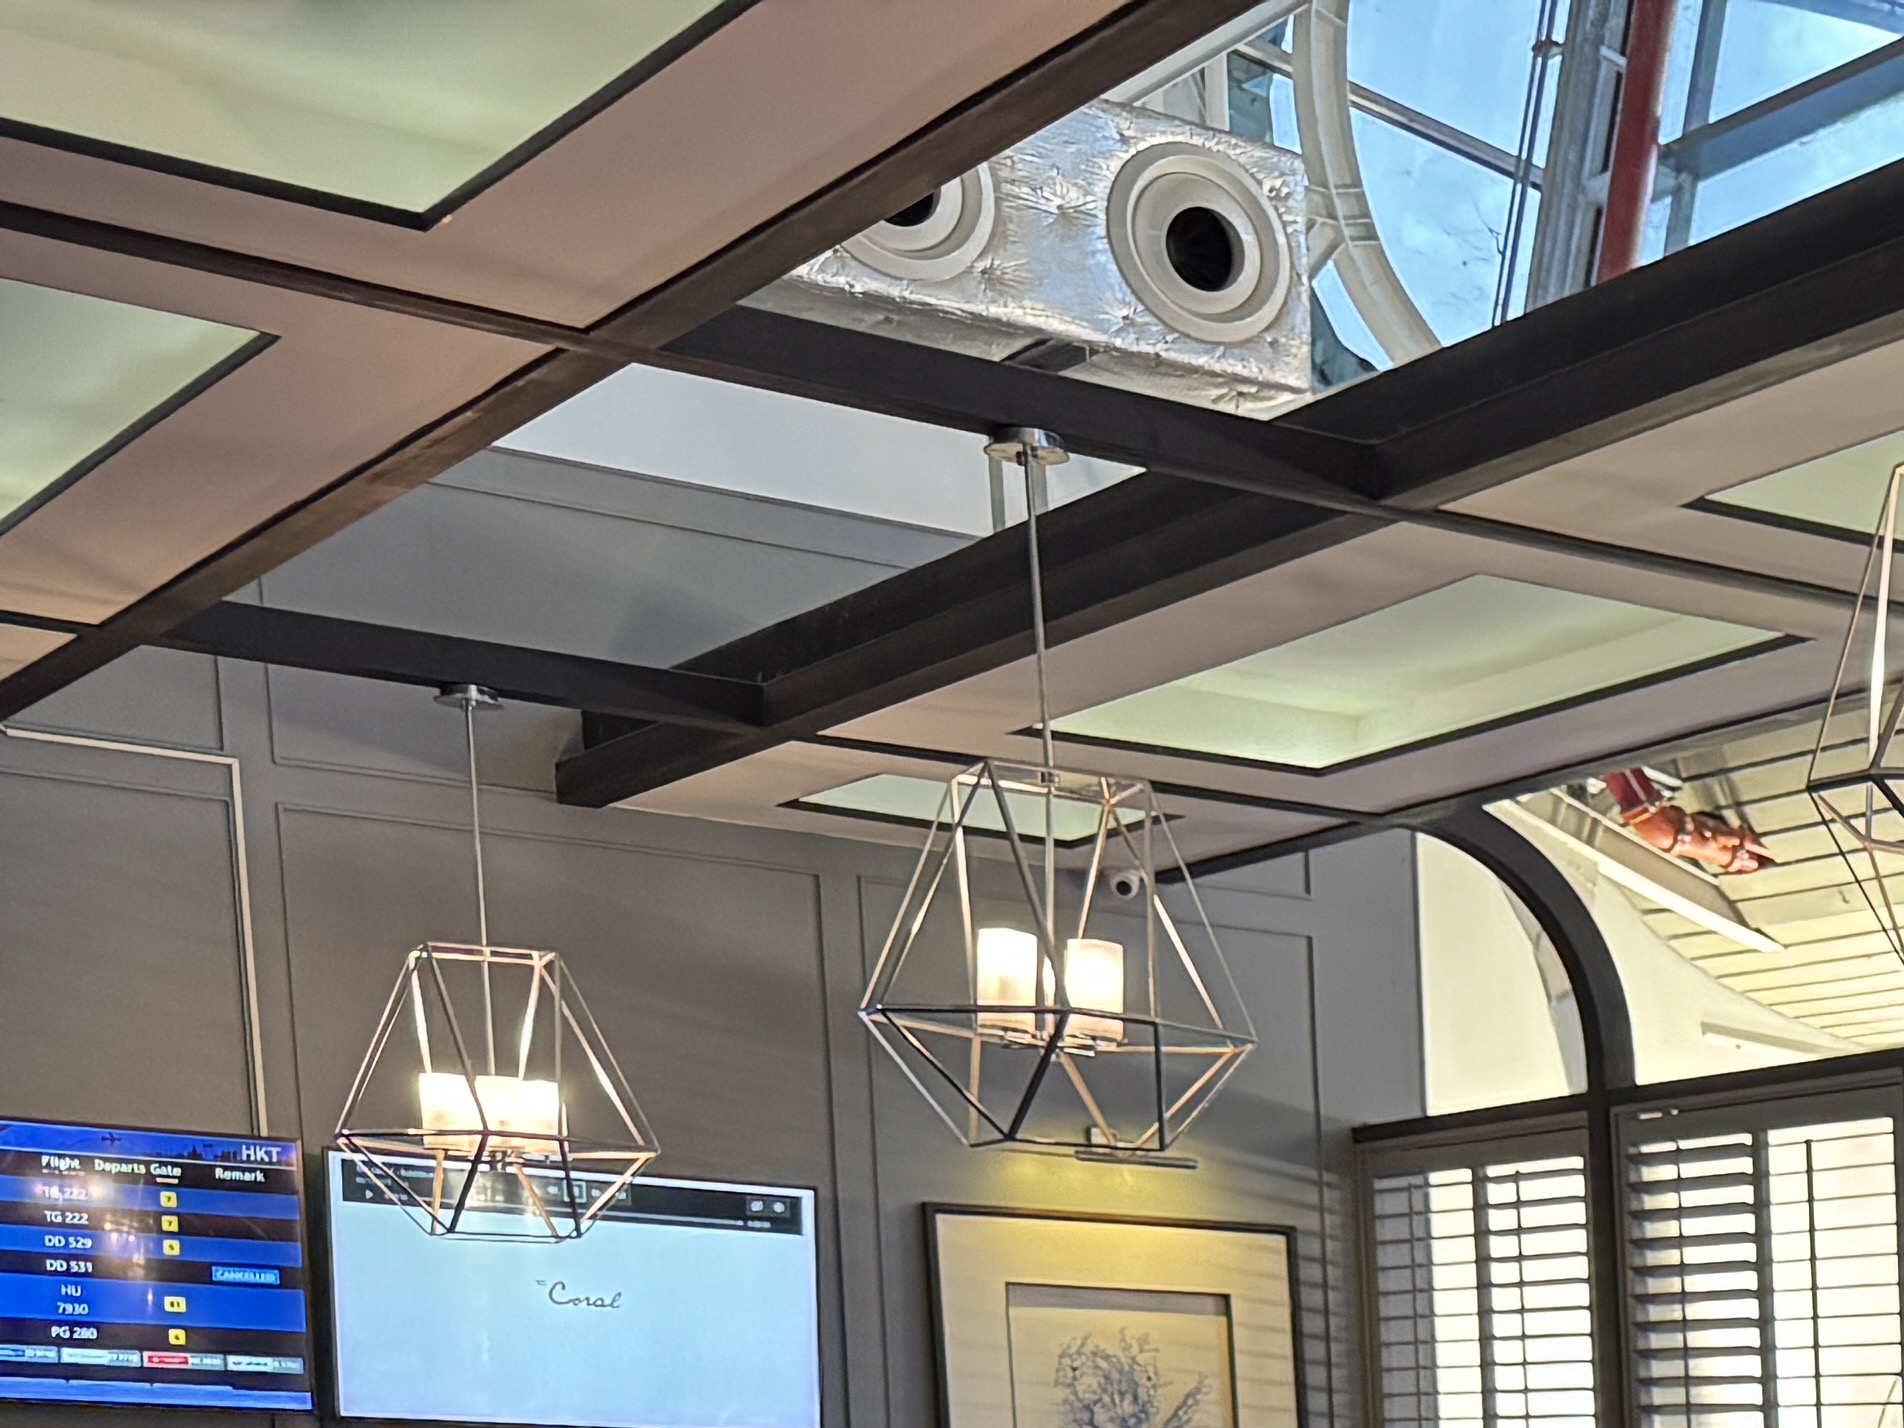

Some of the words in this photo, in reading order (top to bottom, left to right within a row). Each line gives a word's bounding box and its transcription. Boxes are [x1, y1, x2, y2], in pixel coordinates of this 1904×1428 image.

[242, 1145, 281, 1162] HKT
[41, 1155, 81, 1171] Flight
[94, 1158, 146, 1175] Departs
[150, 1163, 182, 1177] Gate
[215, 1167, 265, 1183] Remark
[63, 1187, 88, 1201] 222
[44, 1210, 62, 1223] TG
[65, 1211, 89, 1225] 222
[44, 1235, 66, 1248] DD
[68, 1237, 92, 1249] 529
[45, 1259, 67, 1272] DD
[69, 1261, 93, 1273] 531
[216, 1270, 276, 1283] CANCELLED
[61, 1284, 82, 1297] HU
[547, 1280, 623, 1310] Coral
[51, 1326, 71, 1339] PG
